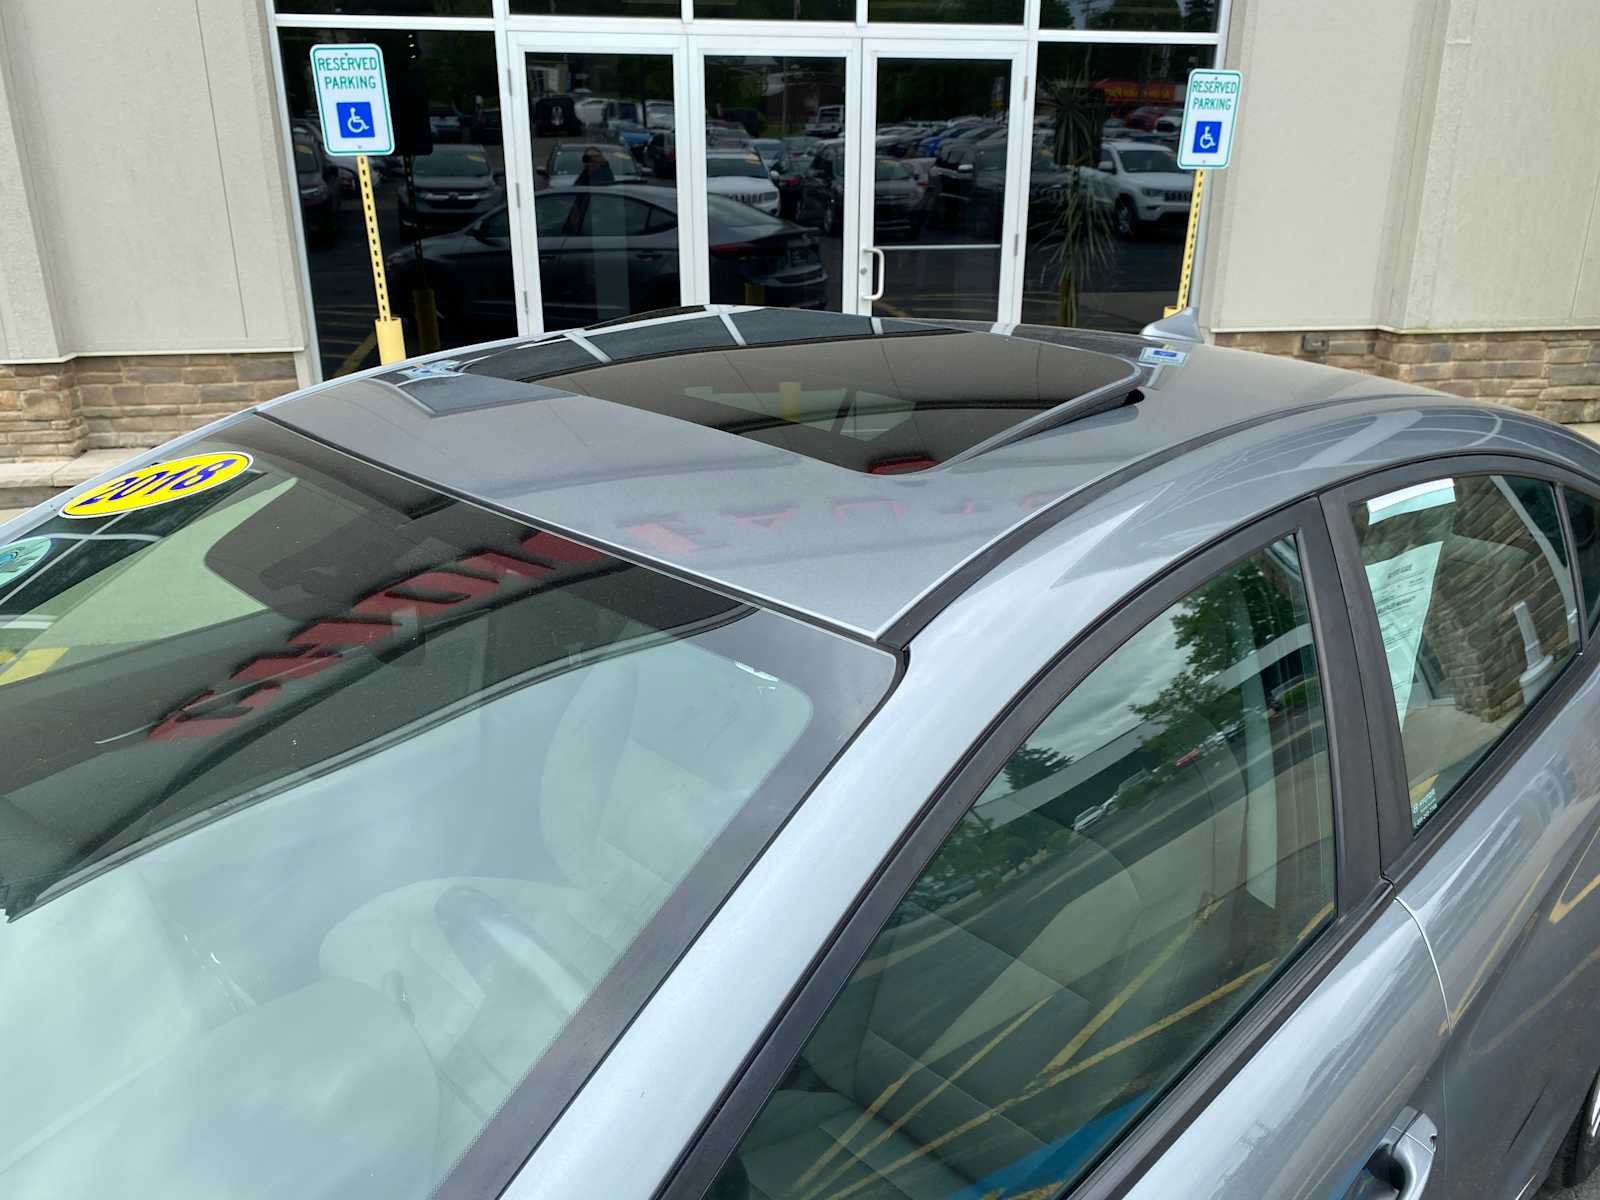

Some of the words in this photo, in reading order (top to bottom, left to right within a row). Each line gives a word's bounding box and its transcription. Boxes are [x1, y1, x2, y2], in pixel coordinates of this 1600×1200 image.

[317, 57, 378, 71] RESERVED
[324, 75, 377, 90] PARKING
[1192, 80, 1238, 94] RESERVED
[1193, 97, 1232, 111] PARKING
[75, 458, 239, 507] 2018
